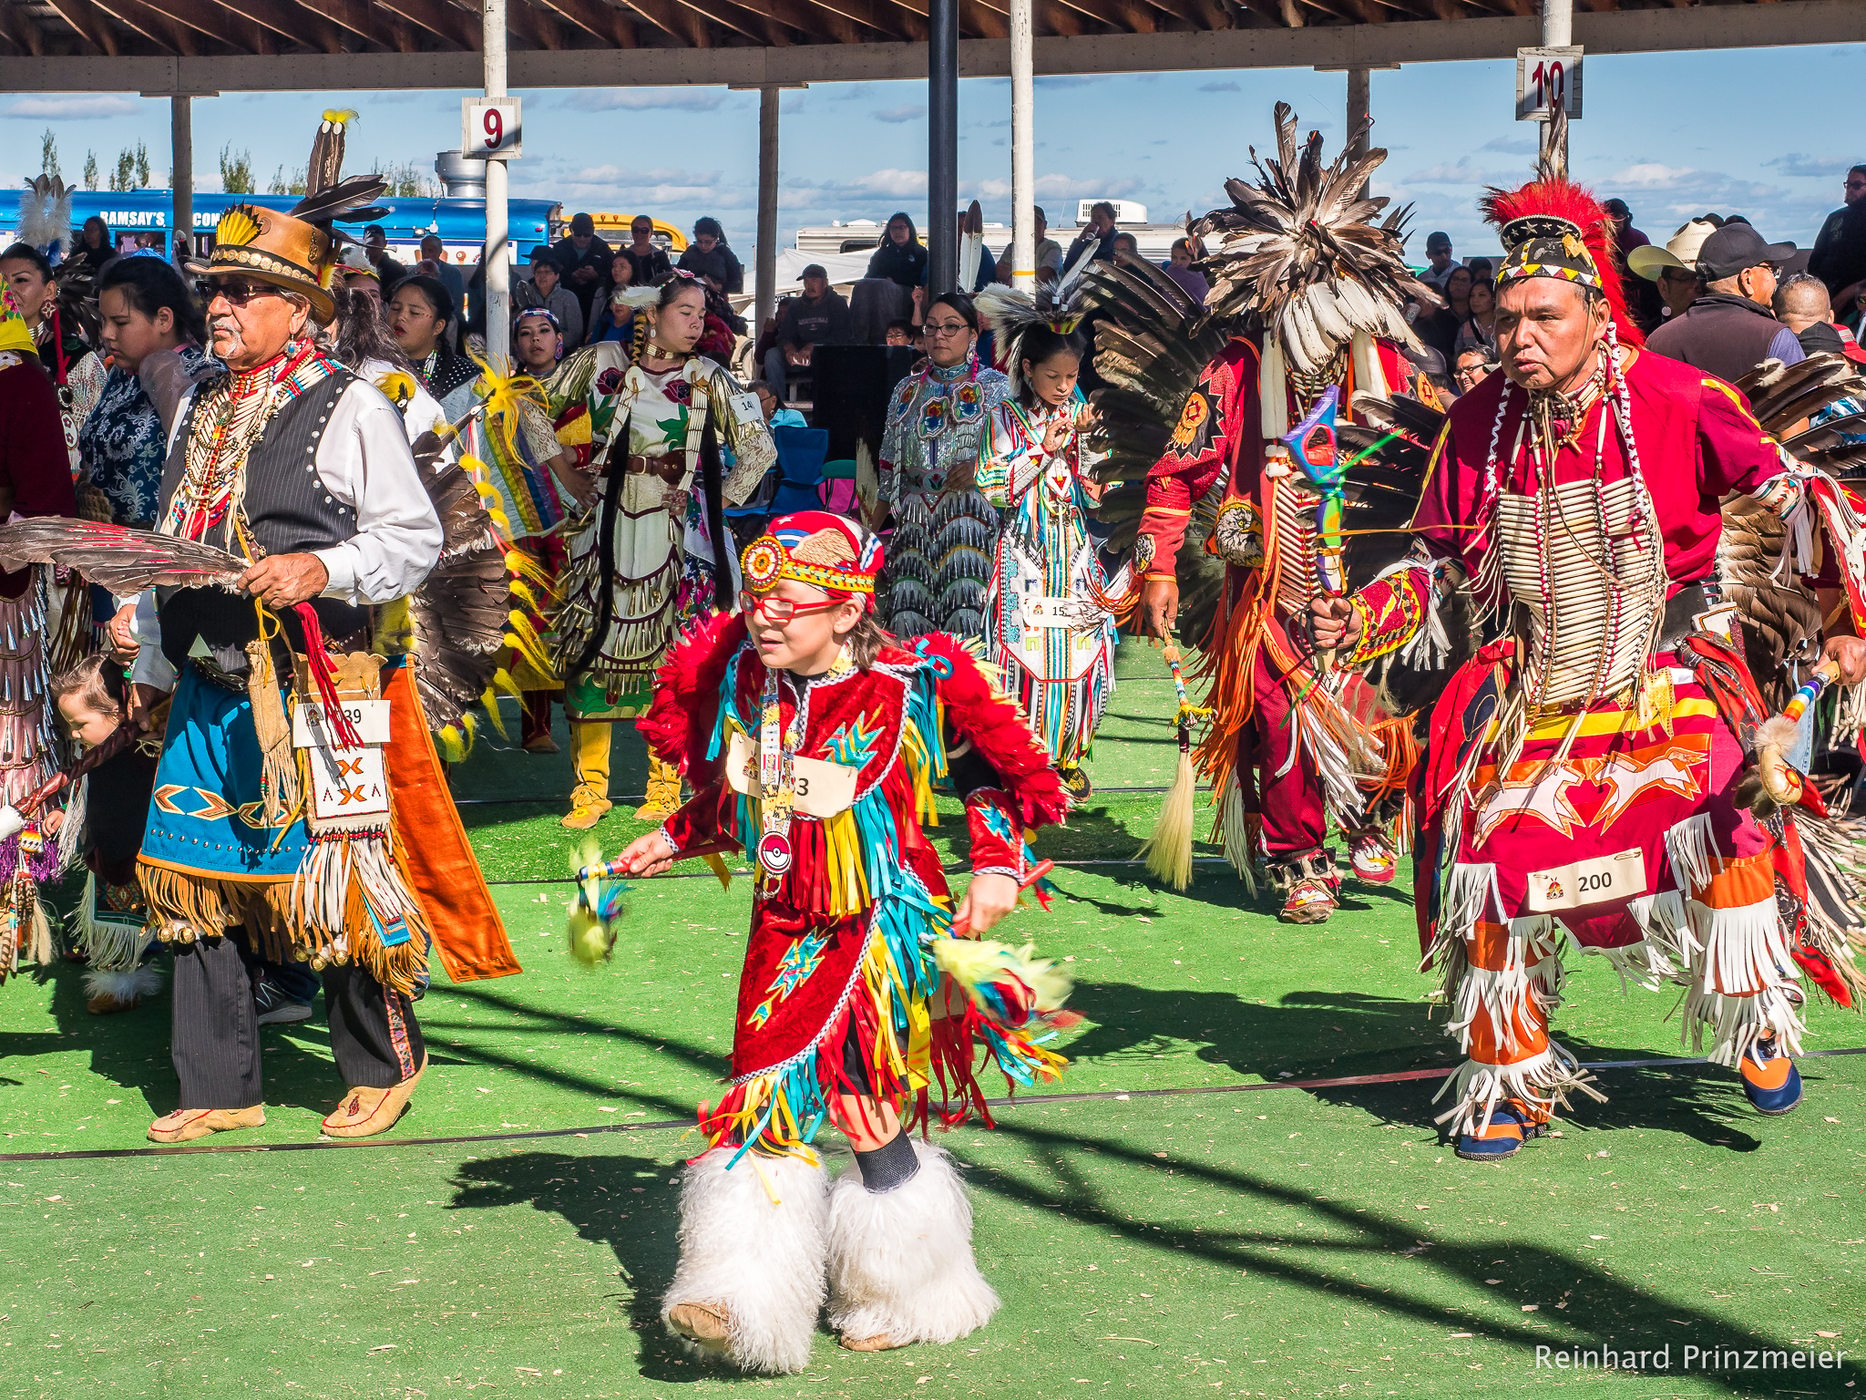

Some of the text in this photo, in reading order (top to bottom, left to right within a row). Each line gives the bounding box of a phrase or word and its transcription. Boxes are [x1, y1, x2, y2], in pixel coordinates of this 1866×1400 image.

[1532, 61, 1564, 108] 10
[483, 108, 503, 149] 9
[100, 211, 165, 226] RAMSAY'S
[1578, 872, 1612, 892] 200
